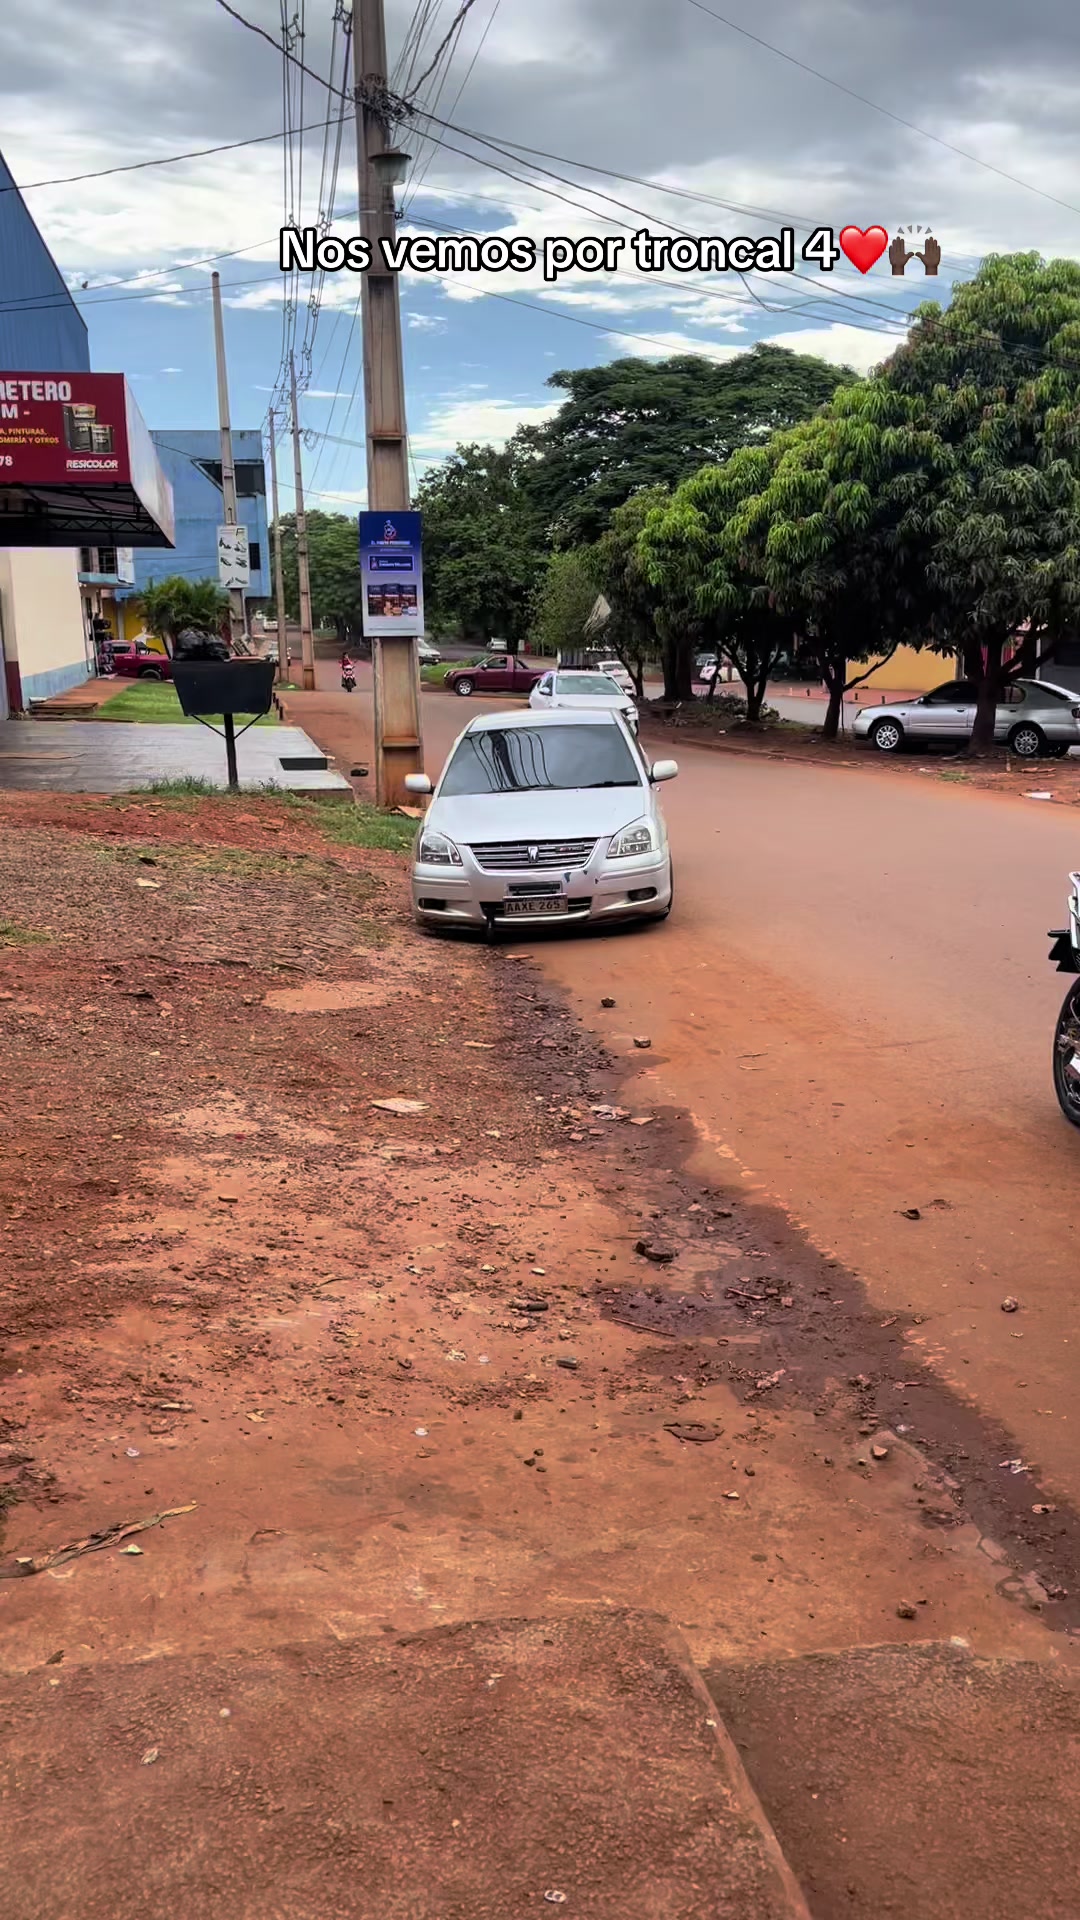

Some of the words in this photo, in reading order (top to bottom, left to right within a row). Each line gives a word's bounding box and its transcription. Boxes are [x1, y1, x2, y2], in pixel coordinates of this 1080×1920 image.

[1, 403, 19, 419] M
[34, 436, 60, 445] OTROS
[66, 459, 119, 469] RESICOLOR
[507, 902, 536, 912] AAXE
[539, 900, 561, 911] 265
